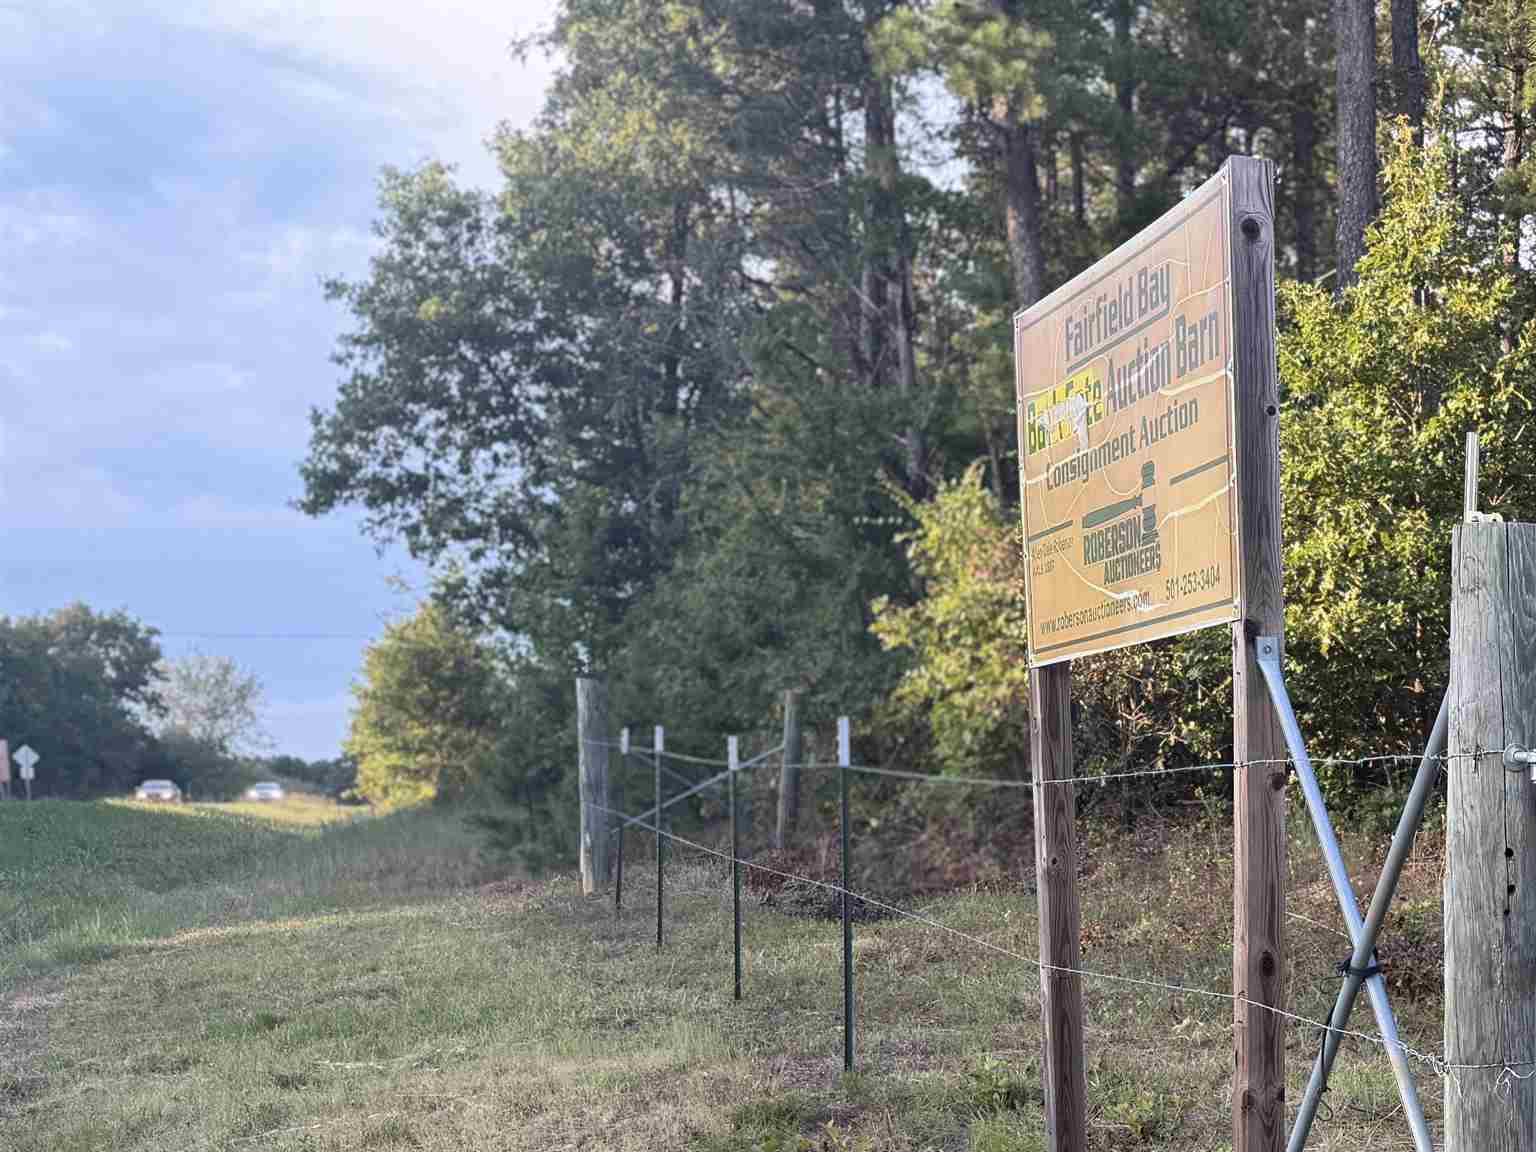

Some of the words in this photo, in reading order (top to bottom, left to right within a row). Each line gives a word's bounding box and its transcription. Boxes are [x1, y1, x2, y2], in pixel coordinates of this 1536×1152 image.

[1065, 273, 1134, 361] Fairfield
[1138, 263, 1170, 319] Bay
[1107, 337, 1172, 416] Auction
[1176, 311, 1219, 378] Barn
[1046, 425, 1136, 490] Consignment
[1139, 397, 1198, 448] Auction
[1083, 514, 1142, 565] ROBERSON
[1104, 543, 1161, 585] AUCTIONEERS
